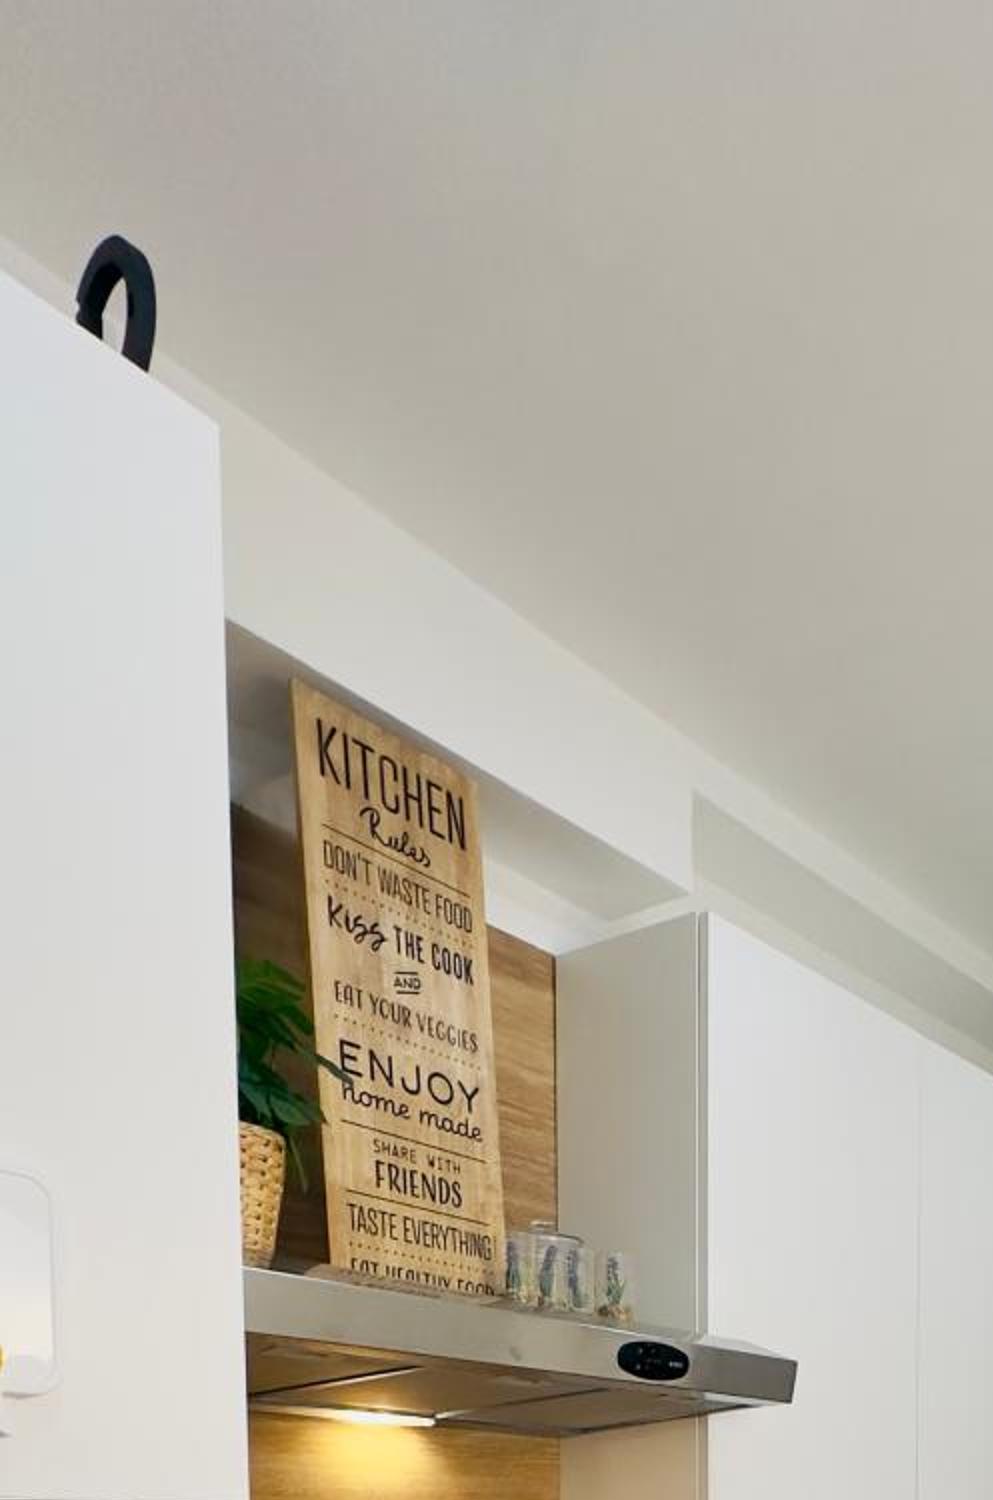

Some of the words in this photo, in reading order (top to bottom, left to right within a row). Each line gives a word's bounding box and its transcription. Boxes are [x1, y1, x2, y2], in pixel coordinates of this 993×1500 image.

[316, 718, 467, 852] KITCHEN
[360, 807, 431, 868] Rules
[323, 839, 372, 886] DON'T
[377, 866, 431, 916] WASTE
[435, 894, 473, 934] FOOD
[393, 925, 425, 964] THE
[431, 943, 475, 986] COOK
[393, 976, 422, 991] AND
[333, 980, 363, 1009] EAT
[369, 995, 413, 1028] YOUR
[416, 1013, 480, 1054] VEGGIES
[339, 1039, 479, 1114] ENJOY
[342, 1083, 412, 1120] home
[419, 1111, 483, 1143] made
[373, 1139, 416, 1164] SHARE
[426, 1156, 461, 1174] WITH
[374, 1159, 462, 1209] FRIENDS
[346, 1202, 398, 1241] TASTE
[403, 1210, 493, 1262] EVERYTHING
